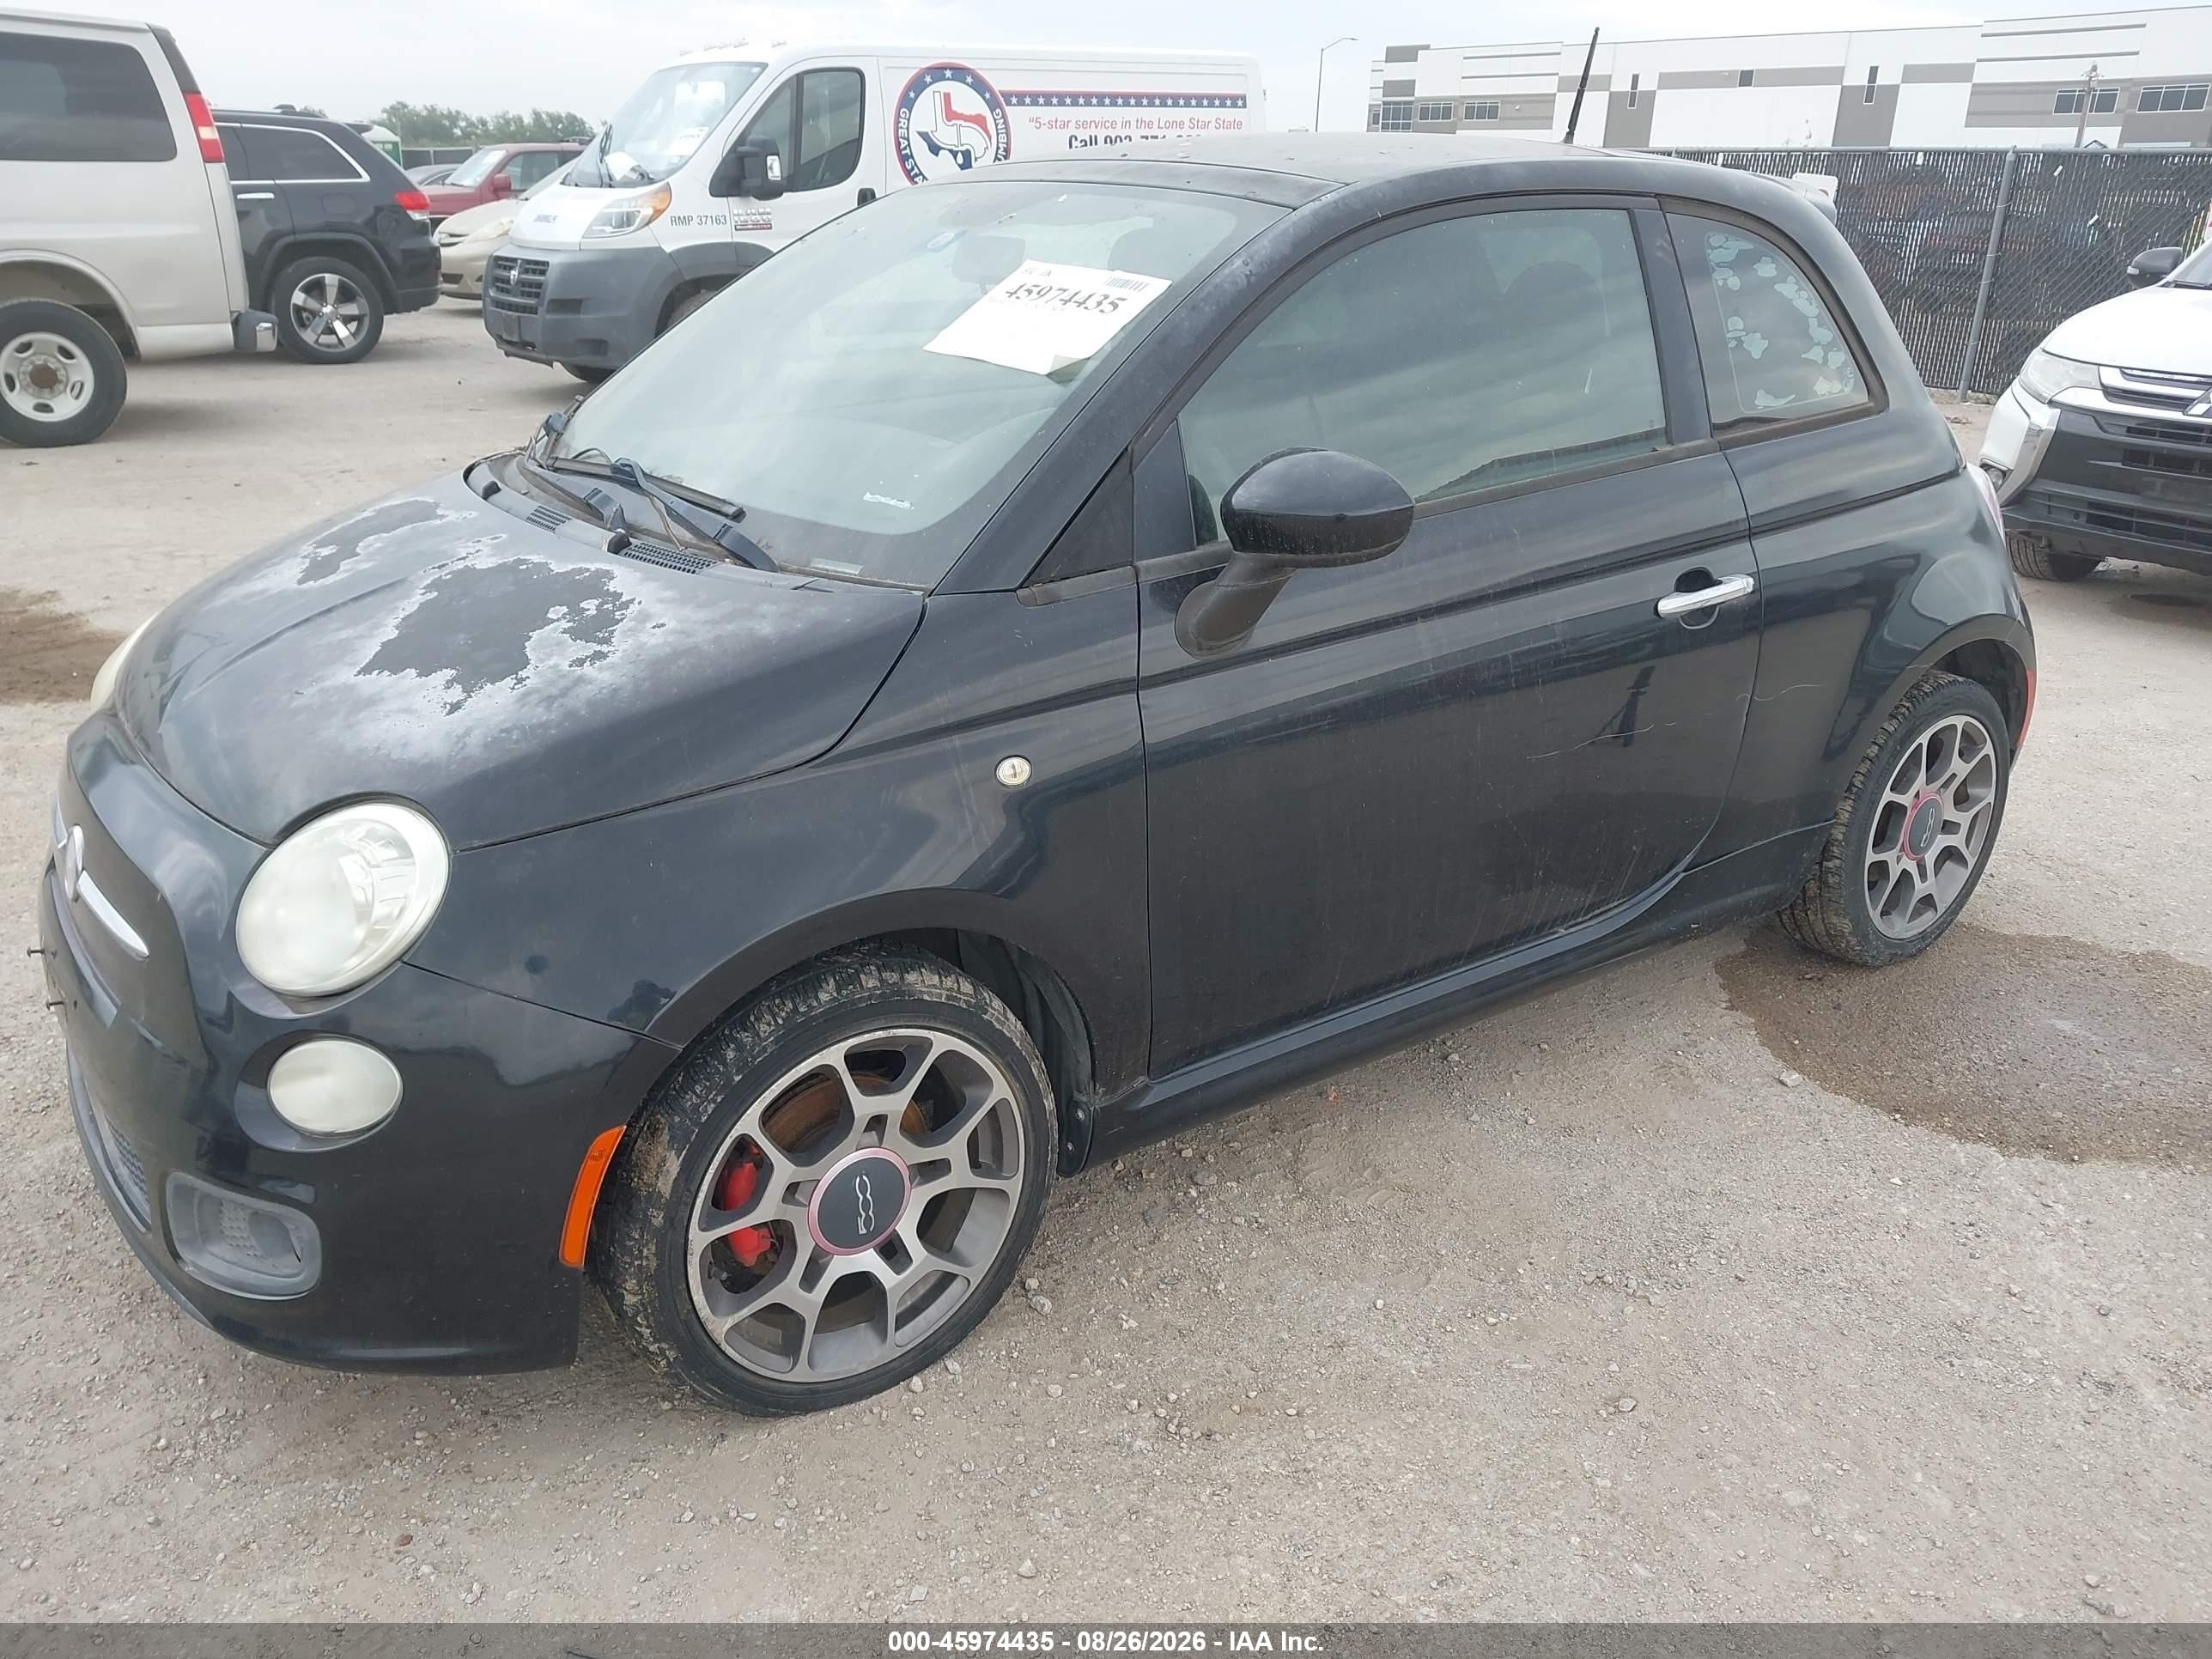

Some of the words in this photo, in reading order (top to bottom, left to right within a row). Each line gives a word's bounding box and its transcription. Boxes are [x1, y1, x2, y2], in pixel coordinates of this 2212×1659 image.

[898, 107, 911, 155] GREAT
[1075, 117, 1117, 130] service
[1121, 117, 1132, 130] in
[1135, 117, 1154, 130] the
[1158, 118, 1185, 131] Lone
[1188, 118, 1212, 131] Star
[1214, 118, 1243, 131] State
[1068, 134, 1098, 149] Call
[670, 215, 694, 227] RMP
[696, 214, 727, 226] 37163
[1005, 283, 1127, 314] 45974435
[855, 1175, 875, 1235] 500
